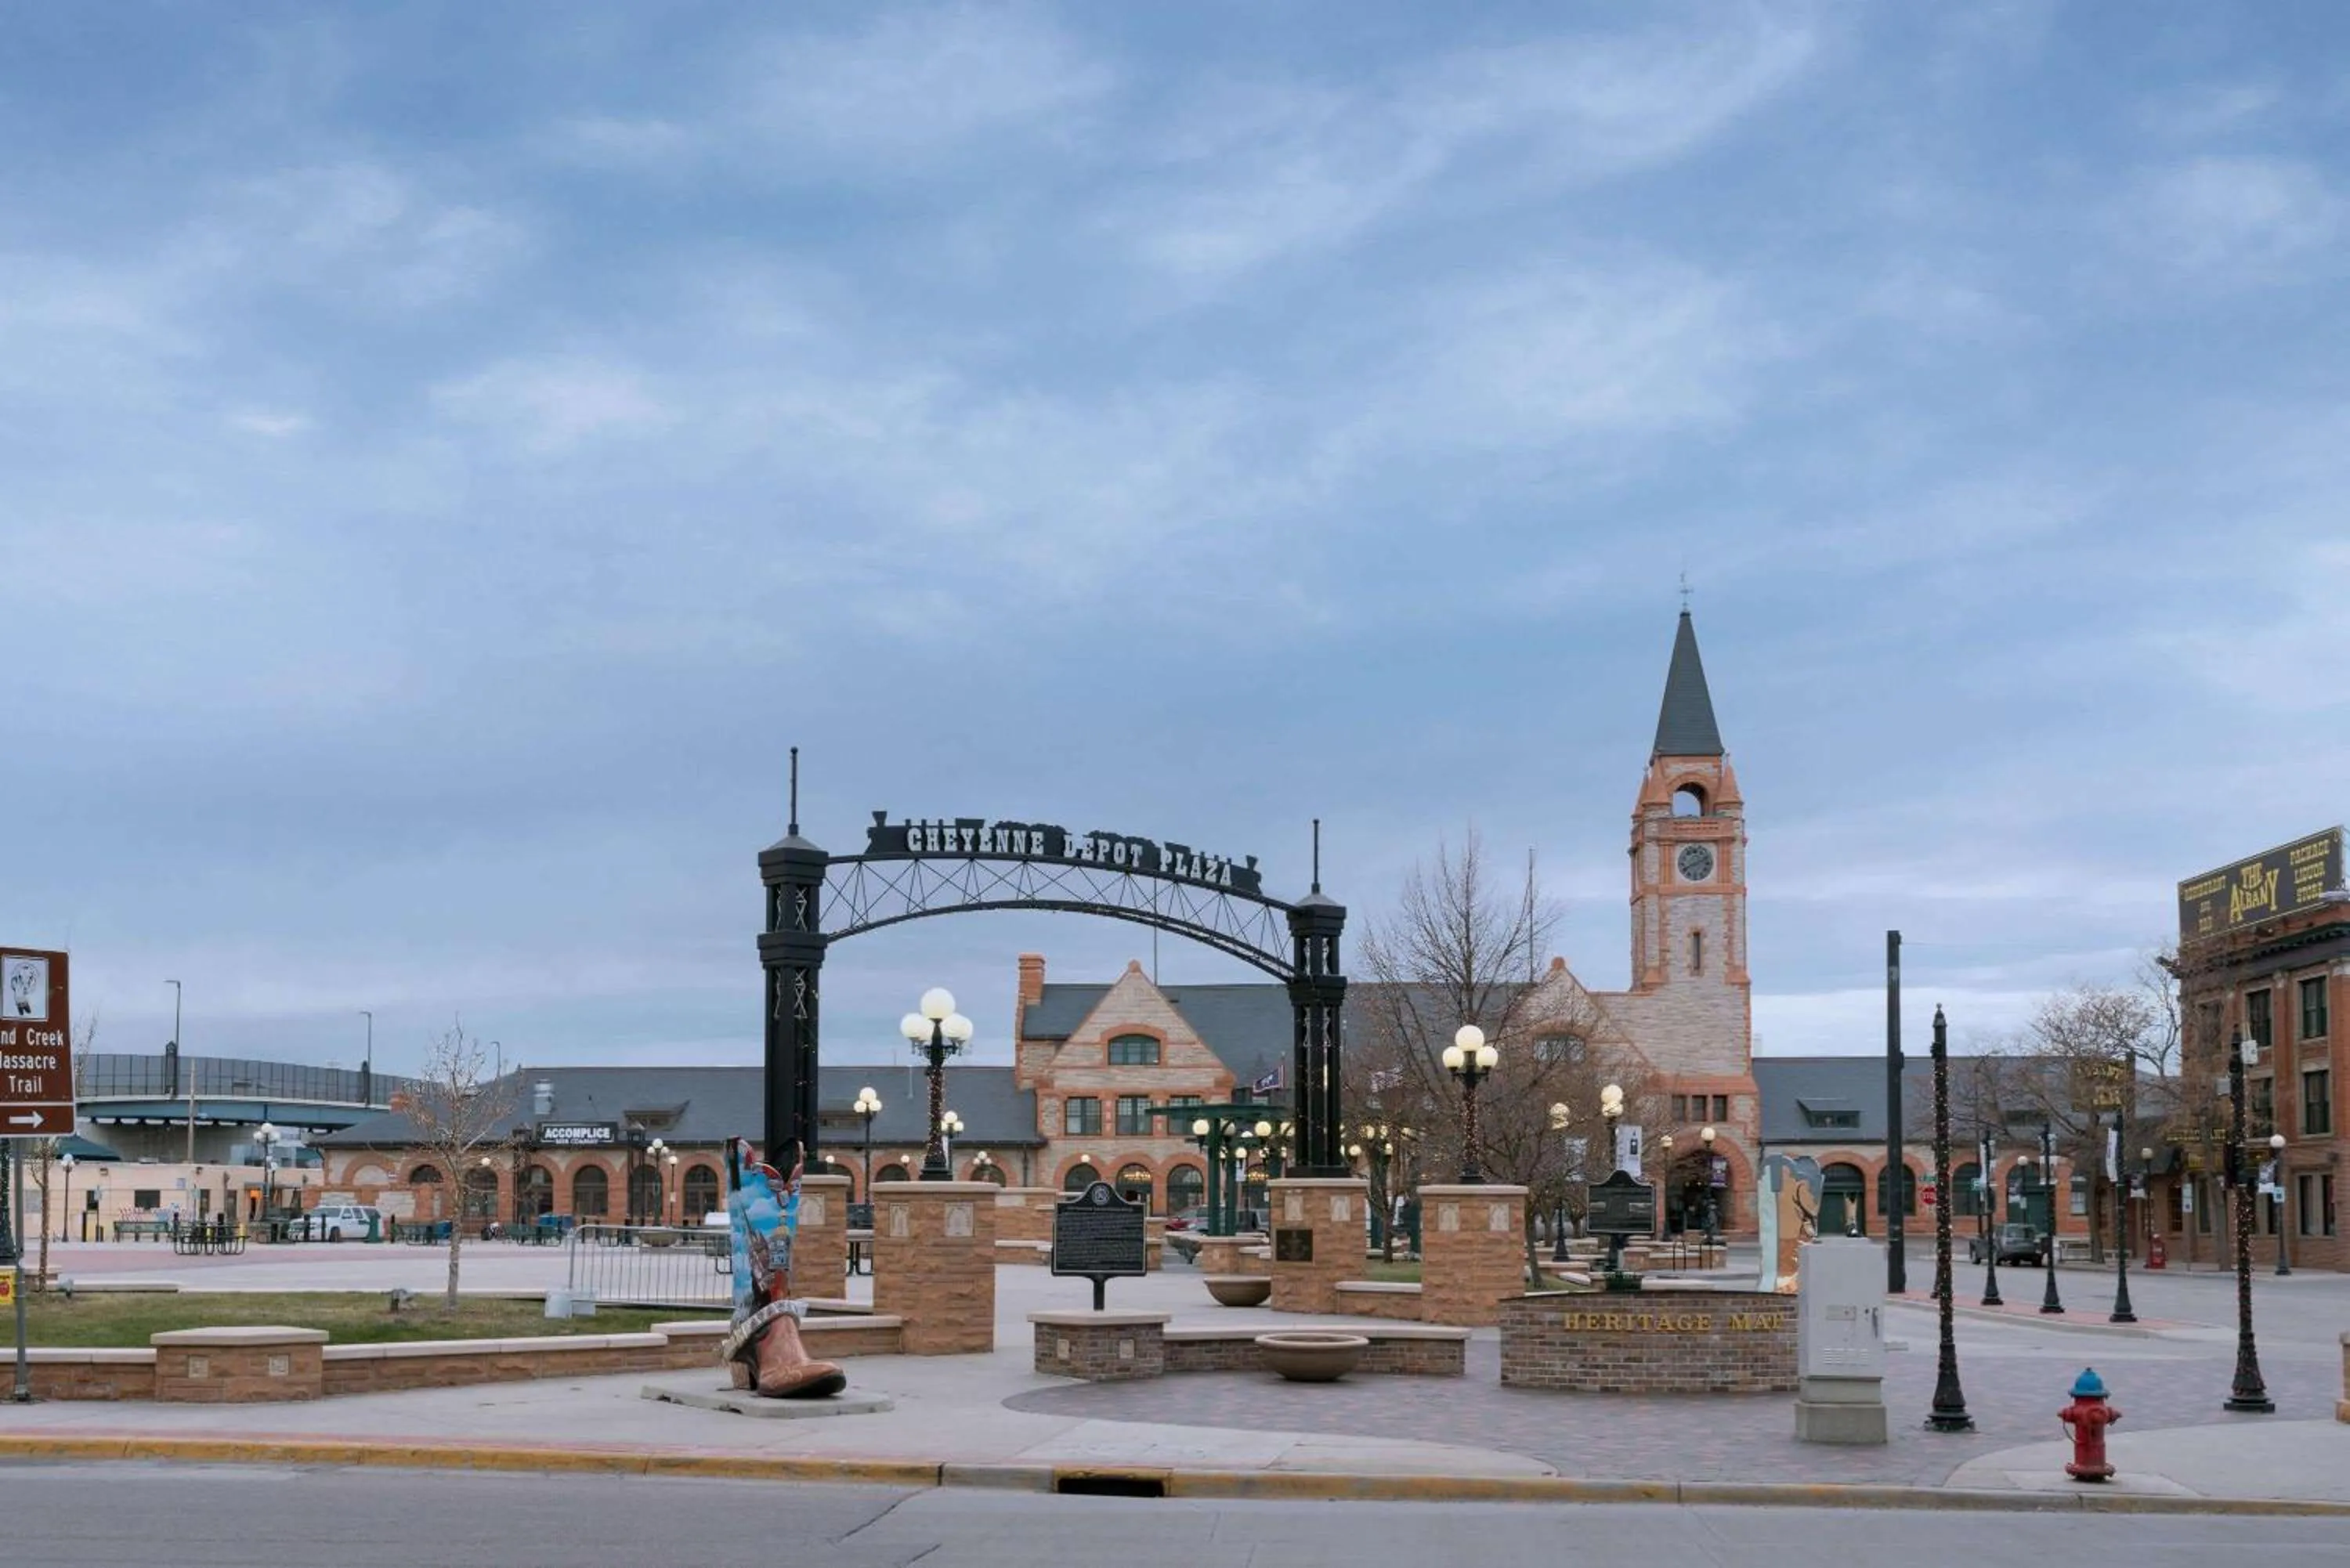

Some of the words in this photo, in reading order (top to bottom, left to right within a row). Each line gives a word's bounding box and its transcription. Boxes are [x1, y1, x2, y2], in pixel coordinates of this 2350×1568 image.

[906, 827, 1044, 855] CHEYENNE
[1063, 834, 1144, 868] DEPOT
[1159, 845, 1233, 886] PLAZA
[2241, 862, 2263, 889] THE
[2229, 868, 2280, 923] ALBANY
[0, 1028, 16, 1045] nd
[26, 1028, 63, 1046] Creek
[9, 1075, 42, 1093] Trail
[544, 1127, 610, 1139] ACCOMPLICE
[1564, 1313, 1712, 1331] HERITAGE
